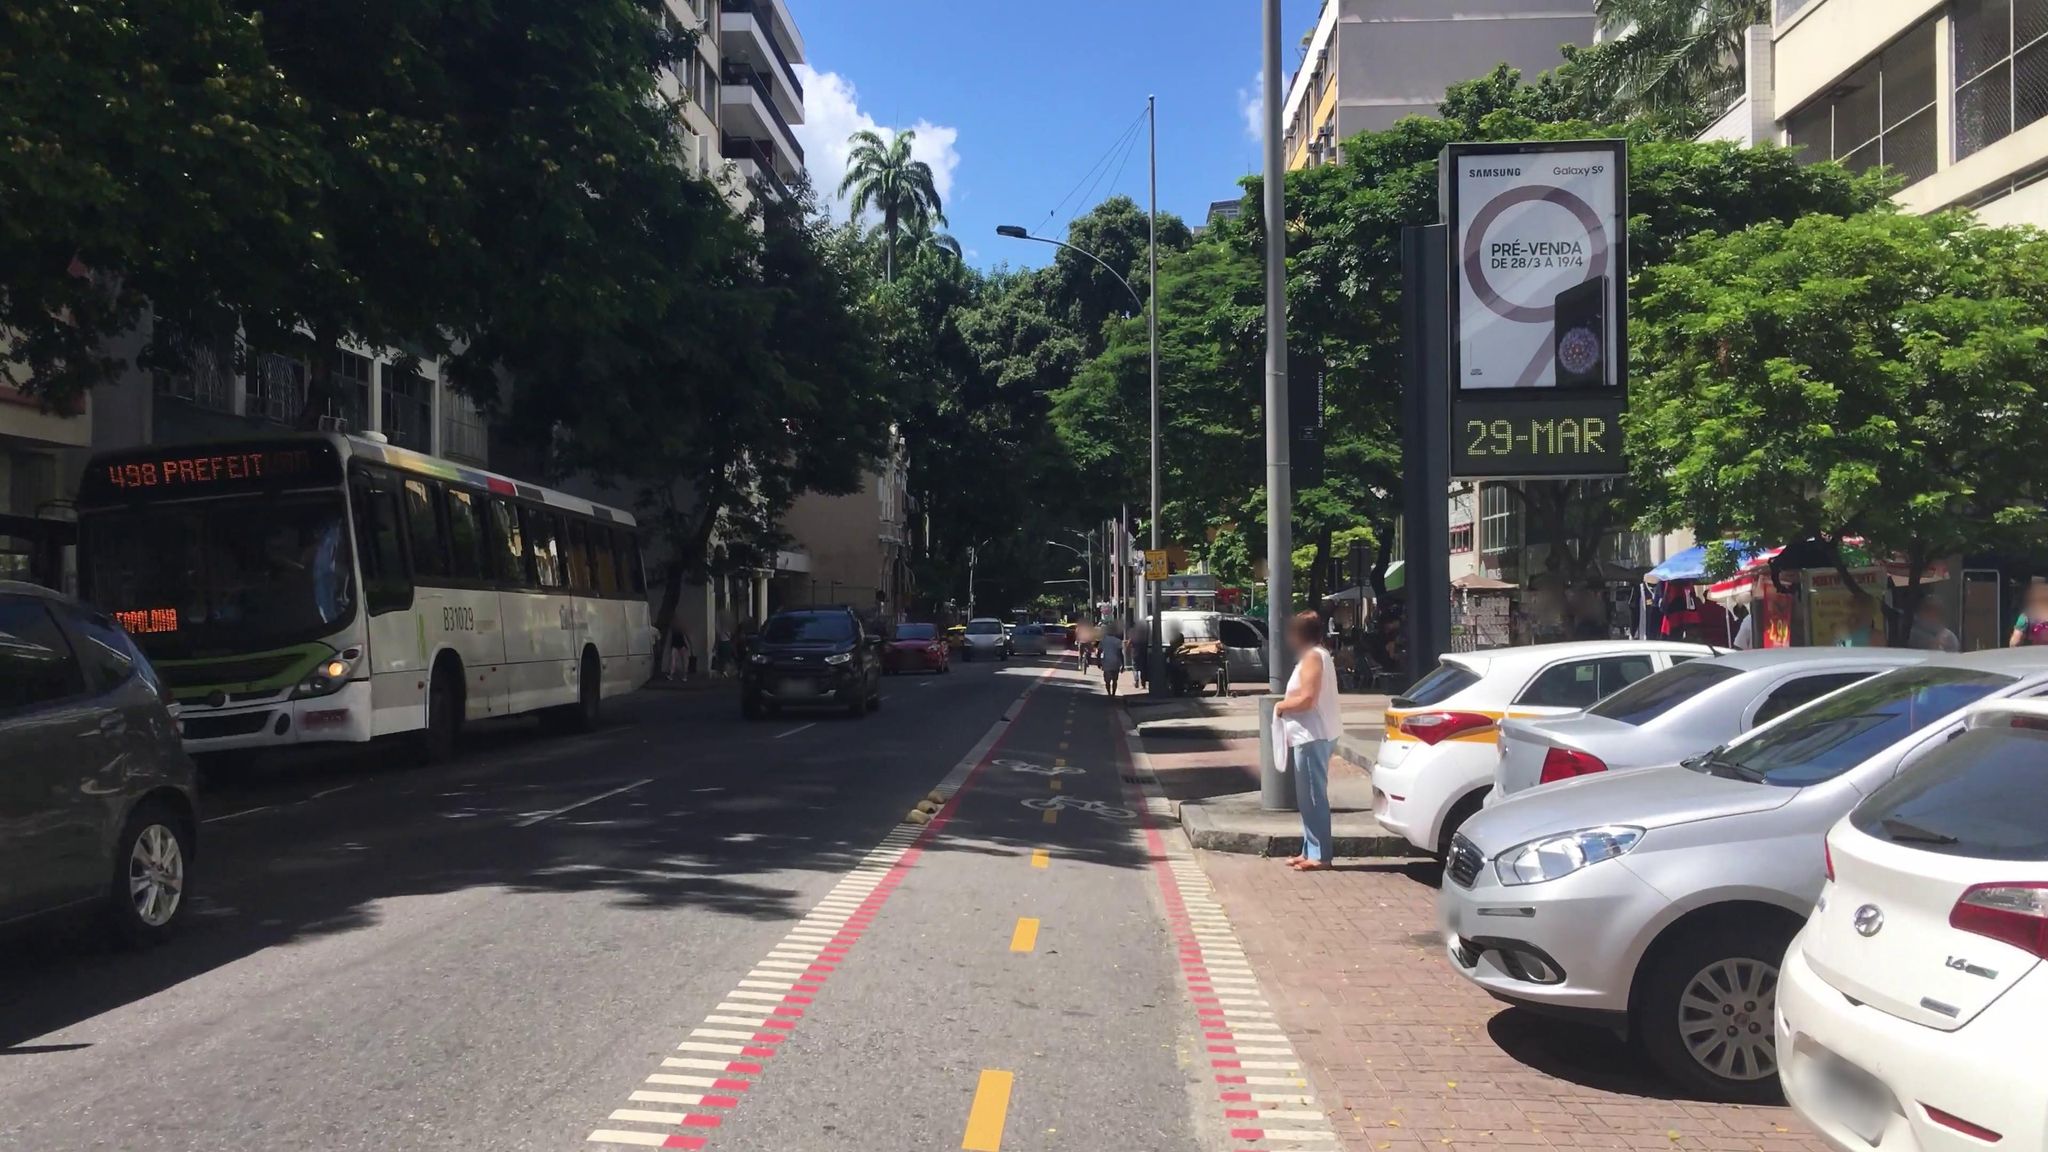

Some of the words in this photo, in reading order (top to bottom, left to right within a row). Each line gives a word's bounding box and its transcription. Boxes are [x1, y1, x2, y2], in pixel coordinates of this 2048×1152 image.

[1469, 168, 1521, 178] SAMSUNG
[1553, 166, 1590, 177] Galaxy
[1592, 165, 1604, 175] S9
[1492, 239, 1582, 257] PRÉ-VENDA
[1492, 258, 1507, 269] DE
[1511, 257, 1540, 269] 28/3
[1545, 257, 1553, 268] A
[1558, 256, 1583, 267] 19/4
[1467, 418, 1605, 455] 29-MAR
[108, 463, 157, 488] 498
[443, 607, 474, 631] B31029
